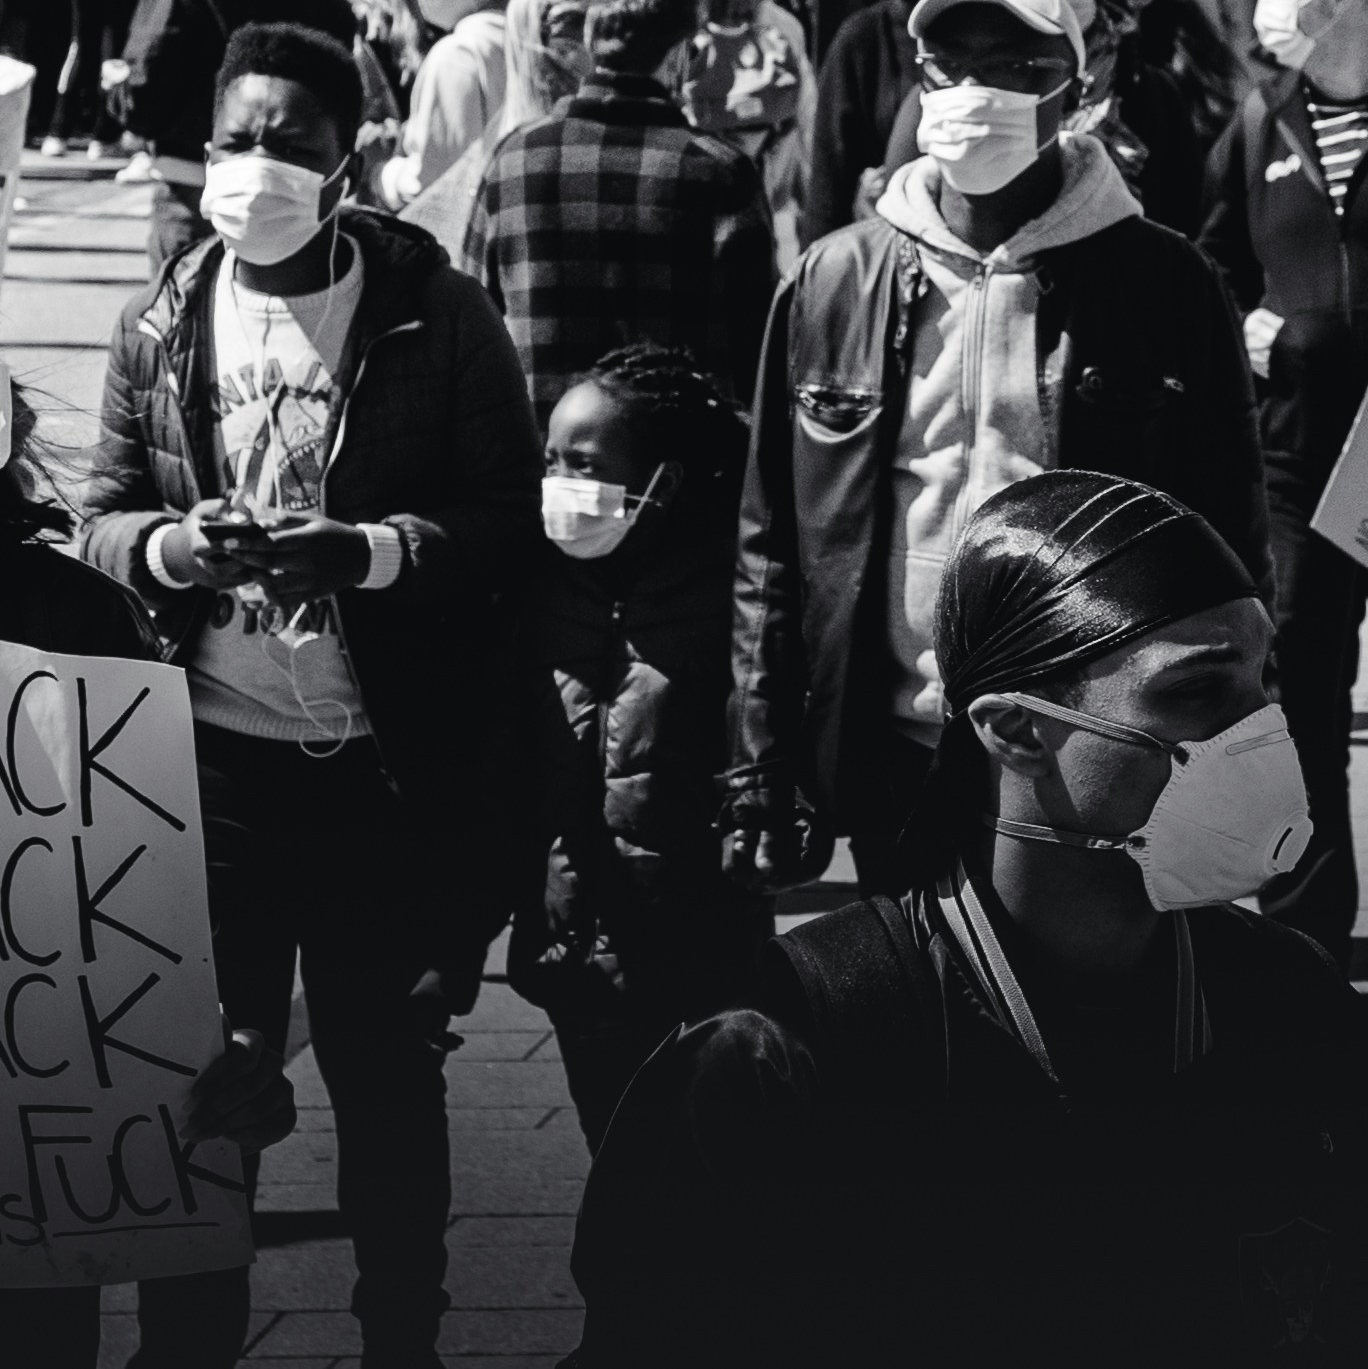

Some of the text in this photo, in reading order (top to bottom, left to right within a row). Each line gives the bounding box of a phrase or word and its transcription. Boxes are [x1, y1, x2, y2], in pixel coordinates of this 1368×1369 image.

[0, 669, 187, 832] CK
[0, 834, 184, 966] CK
[0, 972, 199, 1088] CK
[18, 1103, 247, 1225] FUCK
